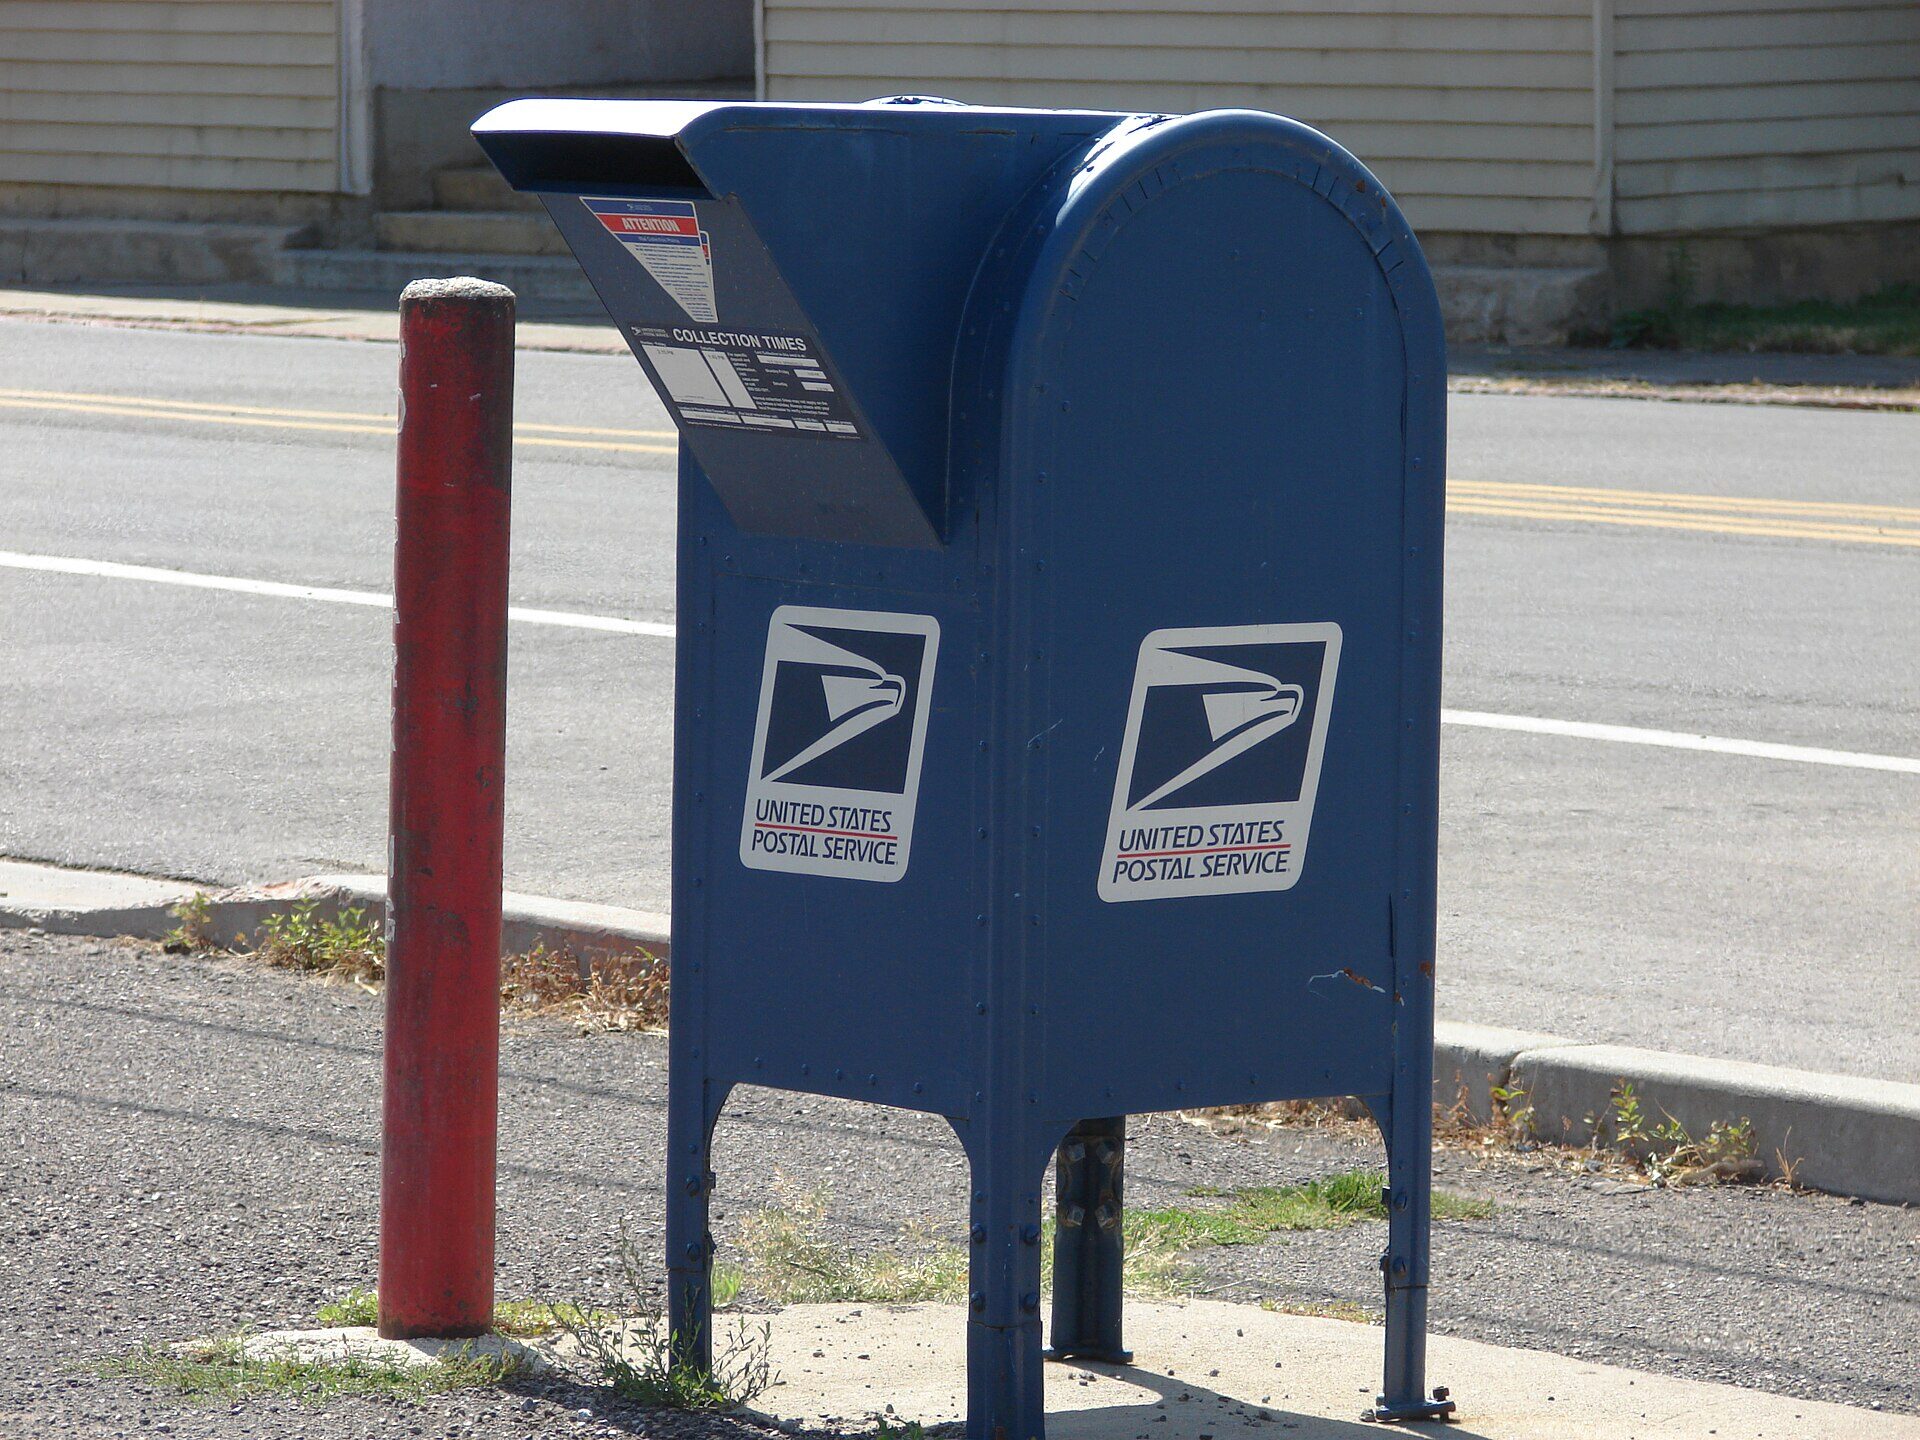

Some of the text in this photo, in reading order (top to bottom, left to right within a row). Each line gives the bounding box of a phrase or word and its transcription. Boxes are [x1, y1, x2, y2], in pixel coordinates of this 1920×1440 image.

[621, 217, 681, 232] ATTENTION
[673, 328, 760, 349] COLLECTION
[762, 336, 807, 352] TIMES
[755, 798, 892, 833] UNITED STATES
[752, 829, 818, 858] POSTAL
[1119, 820, 1284, 852] UNITED STATES
[1113, 857, 1195, 884] POSTAL
